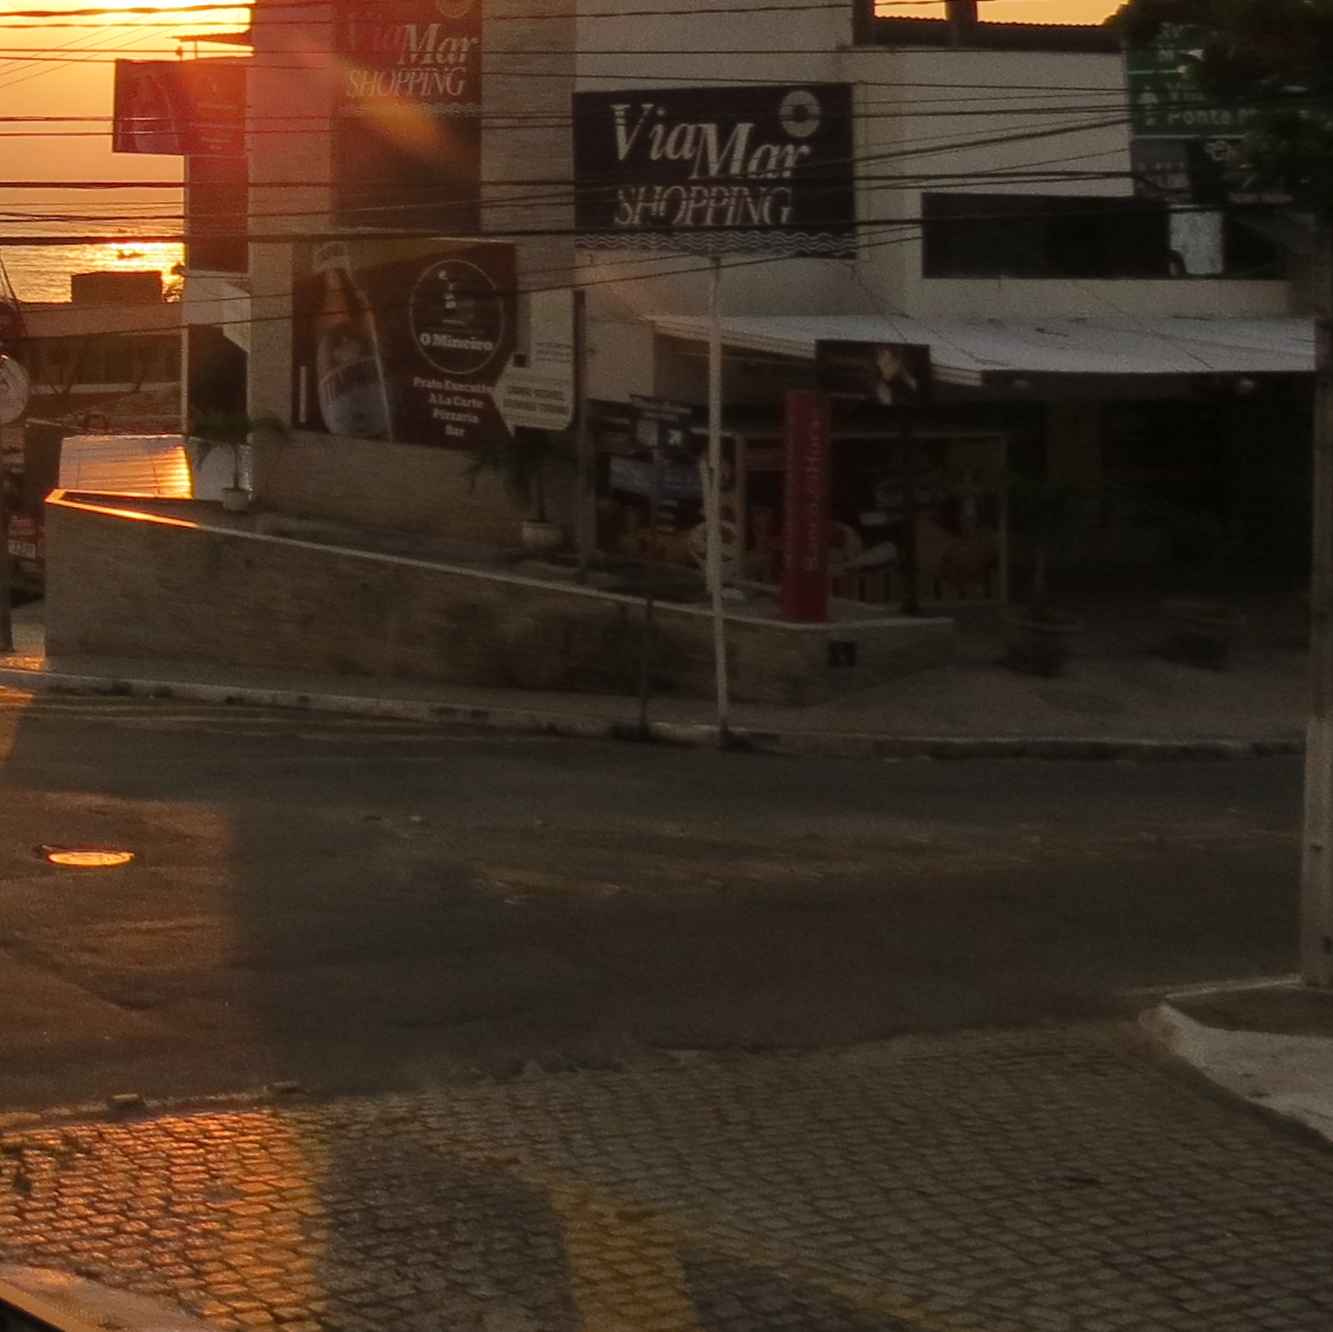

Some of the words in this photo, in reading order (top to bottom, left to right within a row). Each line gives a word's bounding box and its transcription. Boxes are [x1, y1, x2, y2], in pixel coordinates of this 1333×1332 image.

[346, 66, 466, 98] SHOPPING
[614, 185, 793, 225] SHOPPING
[419, 332, 431, 346] O
[432, 334, 494, 351] Mineiro
